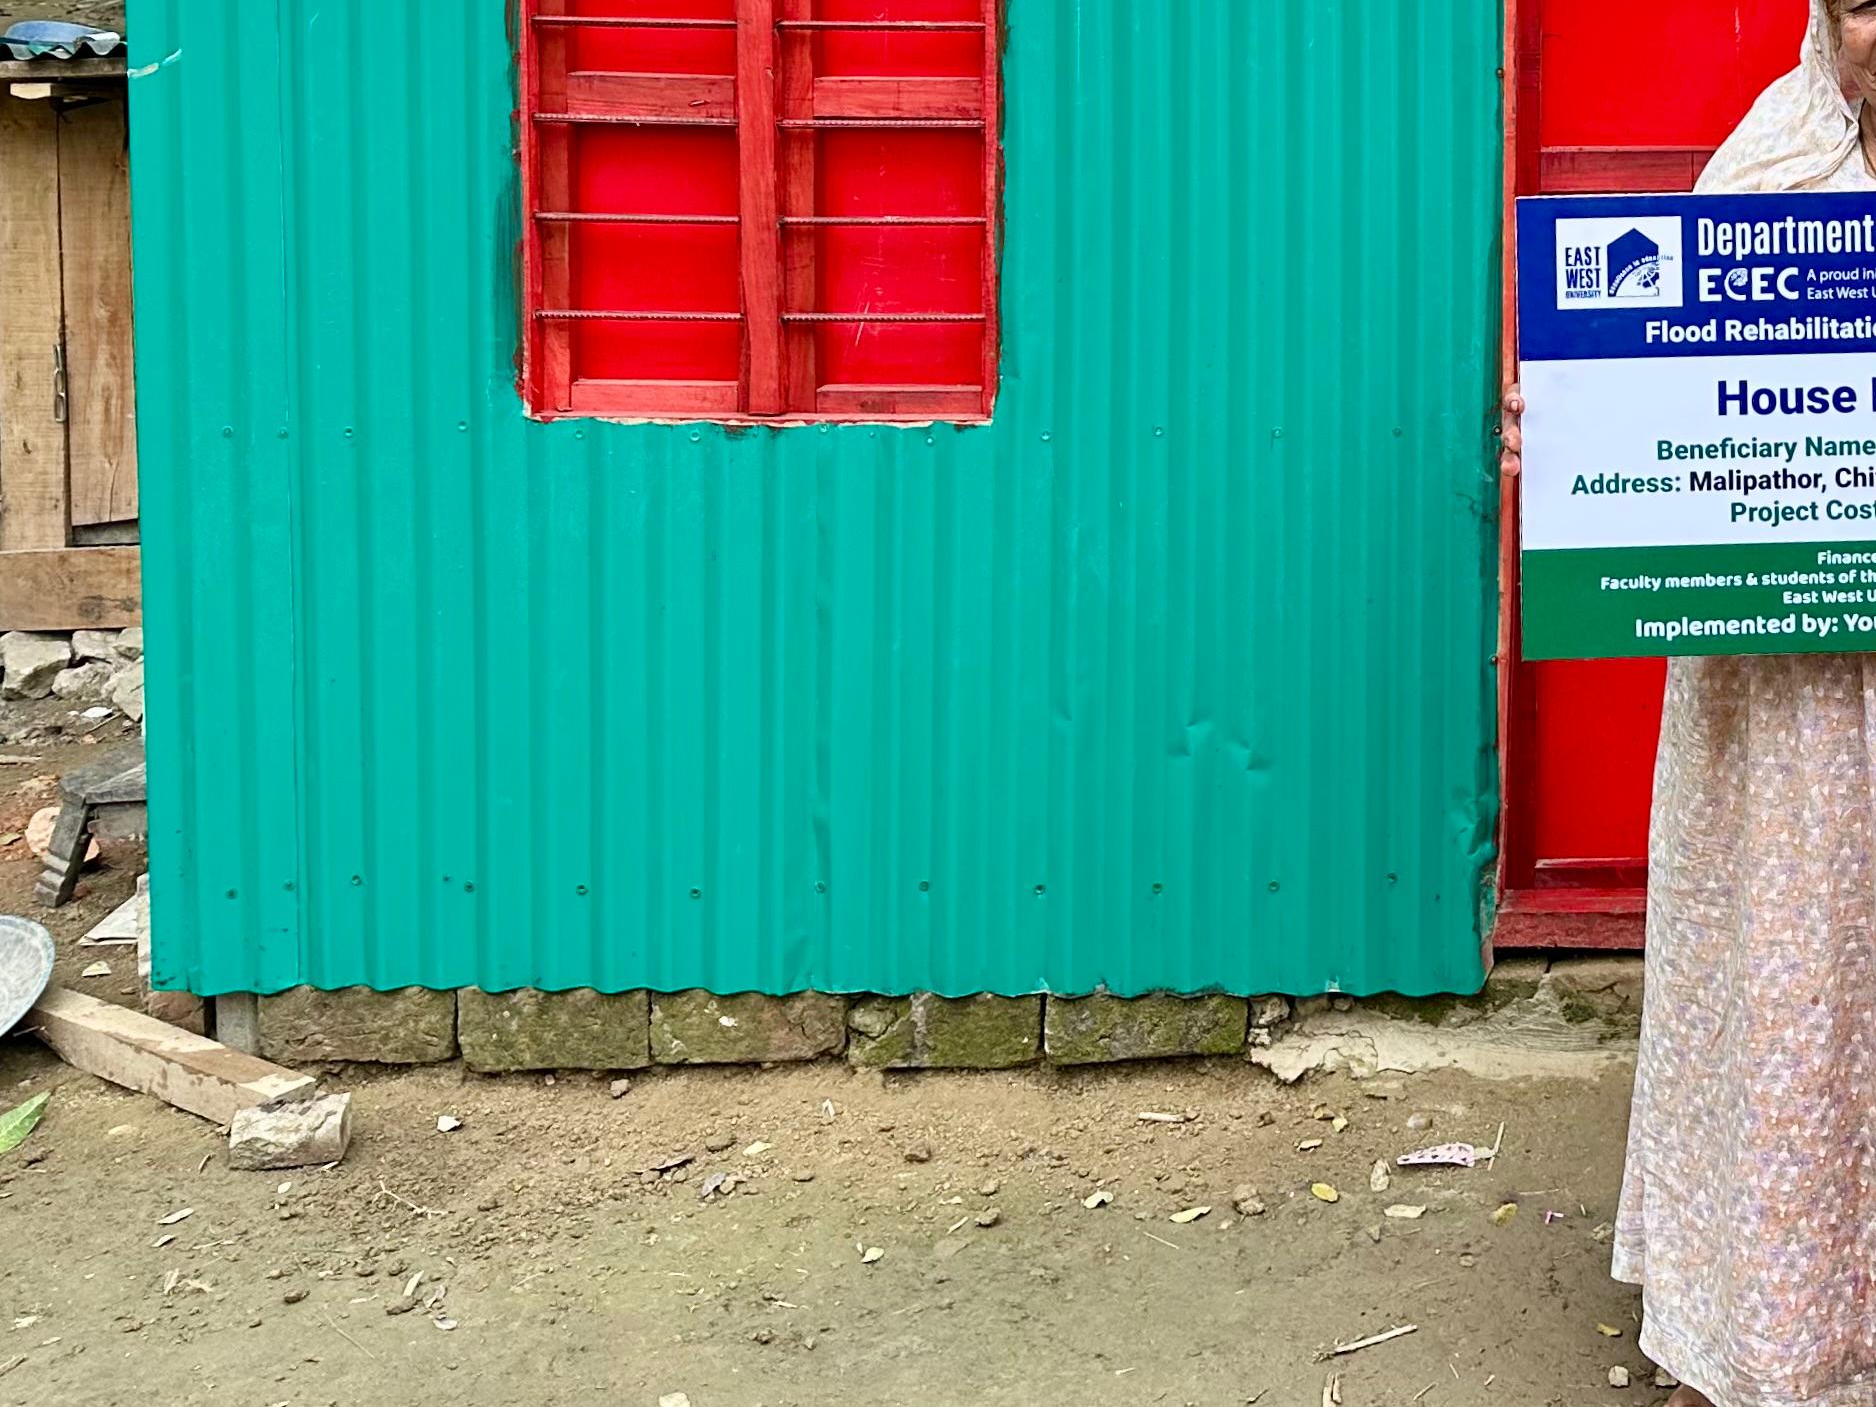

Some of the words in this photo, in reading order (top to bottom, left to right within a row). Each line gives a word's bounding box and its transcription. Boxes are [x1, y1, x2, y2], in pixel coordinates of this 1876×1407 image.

[1697, 216, 1875, 261] Department
[1565, 246, 1601, 267] EAST
[1565, 268, 1602, 289] WEST
[1806, 268, 1817, 282] A
[1819, 267, 1859, 284] proud
[1807, 287, 1834, 300] East
[1836, 286, 1869, 299] West
[1645, 318, 1717, 343] Flood
[1717, 379, 1857, 416] House
[1656, 437, 1797, 463] Beneficiary
[1571, 473, 1681, 494] Address:
[1689, 468, 1827, 495] Malipathor,
[1730, 500, 1818, 527] Project
[1600, 575, 1661, 592] Faculty
[1665, 573, 1742, 589] members
[1745, 572, 1759, 587] &
[1761, 571, 1835, 586] students
[1838, 570, 1856, 584] of
[1782, 591, 1818, 605] East
[1822, 590, 1863, 604] West
[1635, 614, 1797, 642] Implemented
[1801, 613, 1839, 638] by:
